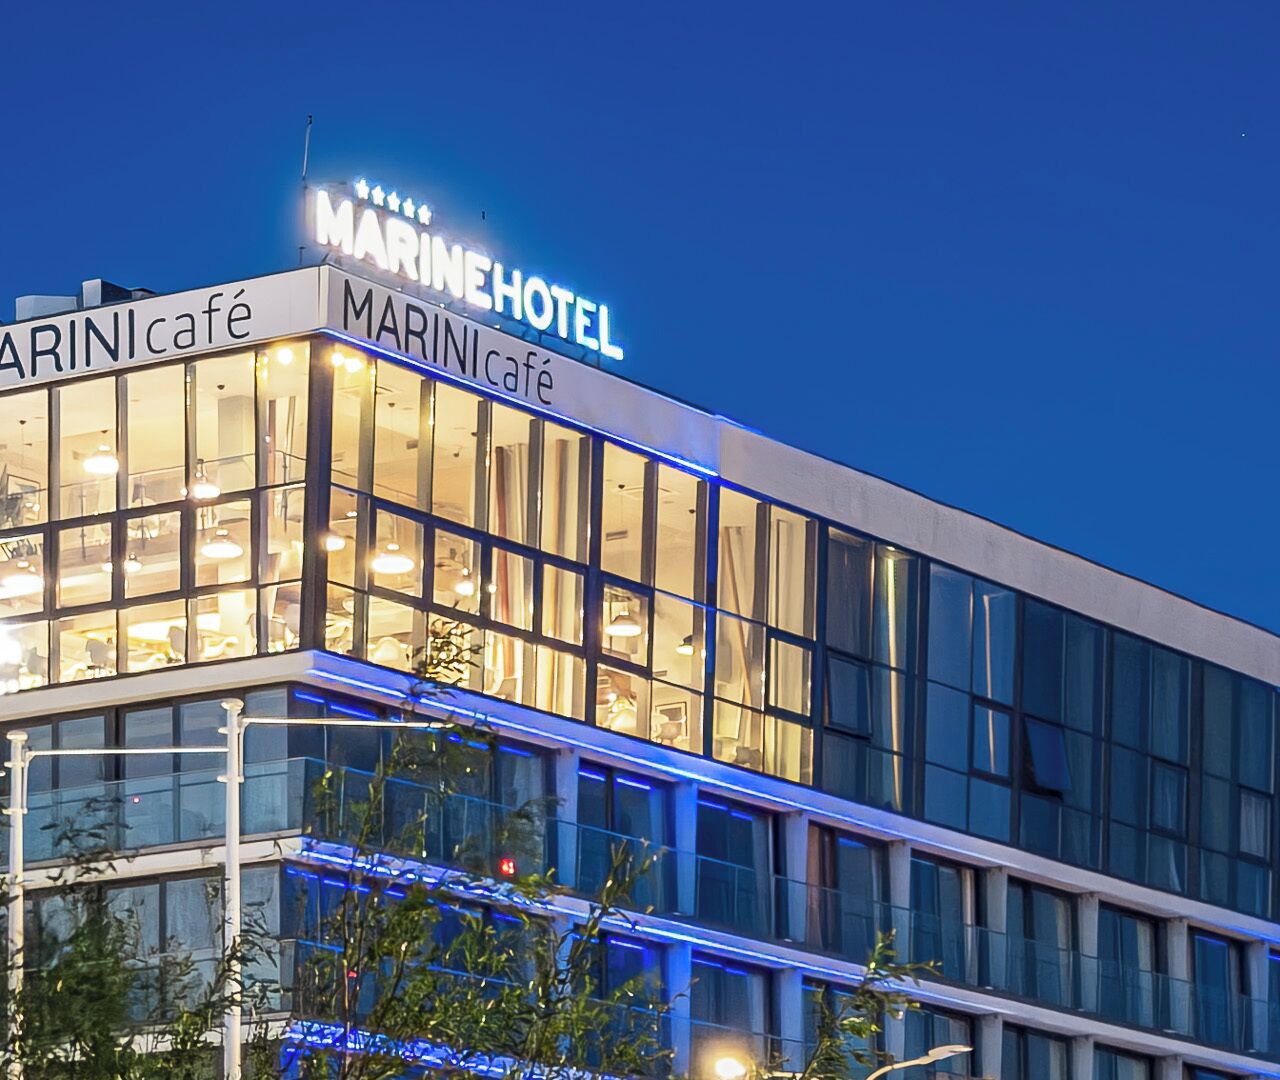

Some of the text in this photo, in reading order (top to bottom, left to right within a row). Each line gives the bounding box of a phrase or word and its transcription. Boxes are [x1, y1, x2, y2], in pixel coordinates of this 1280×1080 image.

[145, 288, 252, 355] café
[343, 278, 554, 406] MARINI café
